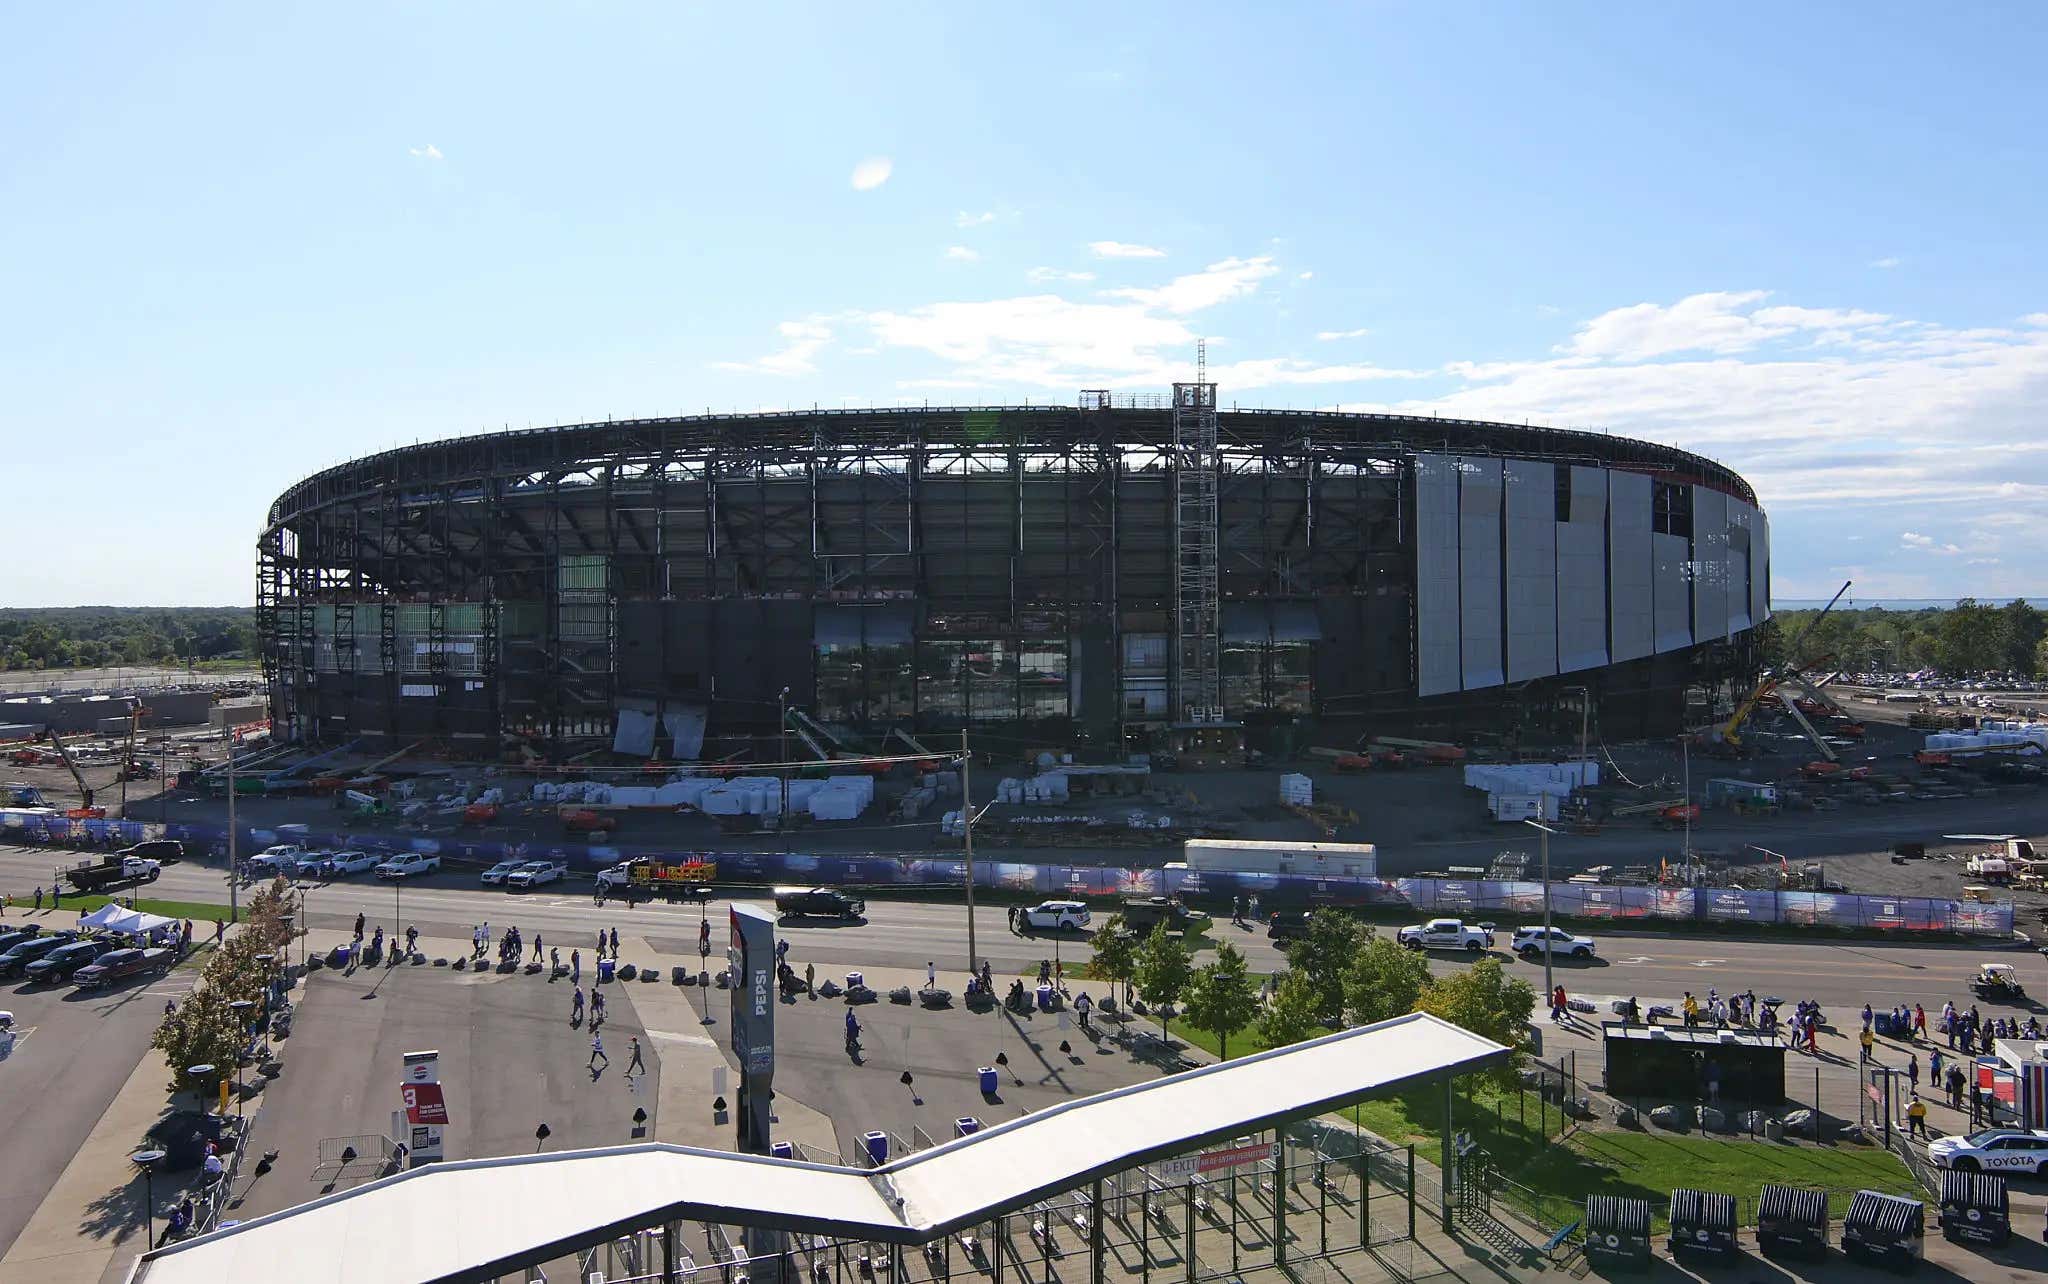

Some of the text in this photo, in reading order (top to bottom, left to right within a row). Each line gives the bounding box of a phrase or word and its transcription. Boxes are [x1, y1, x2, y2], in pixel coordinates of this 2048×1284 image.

[756, 970, 767, 1016] PEPSI
[404, 1089, 417, 1108] 3
[1273, 1145, 1280, 1156] 3
[1174, 1159, 1196, 1172] EXIT
[1986, 1156, 2035, 1168] TOYOTA
